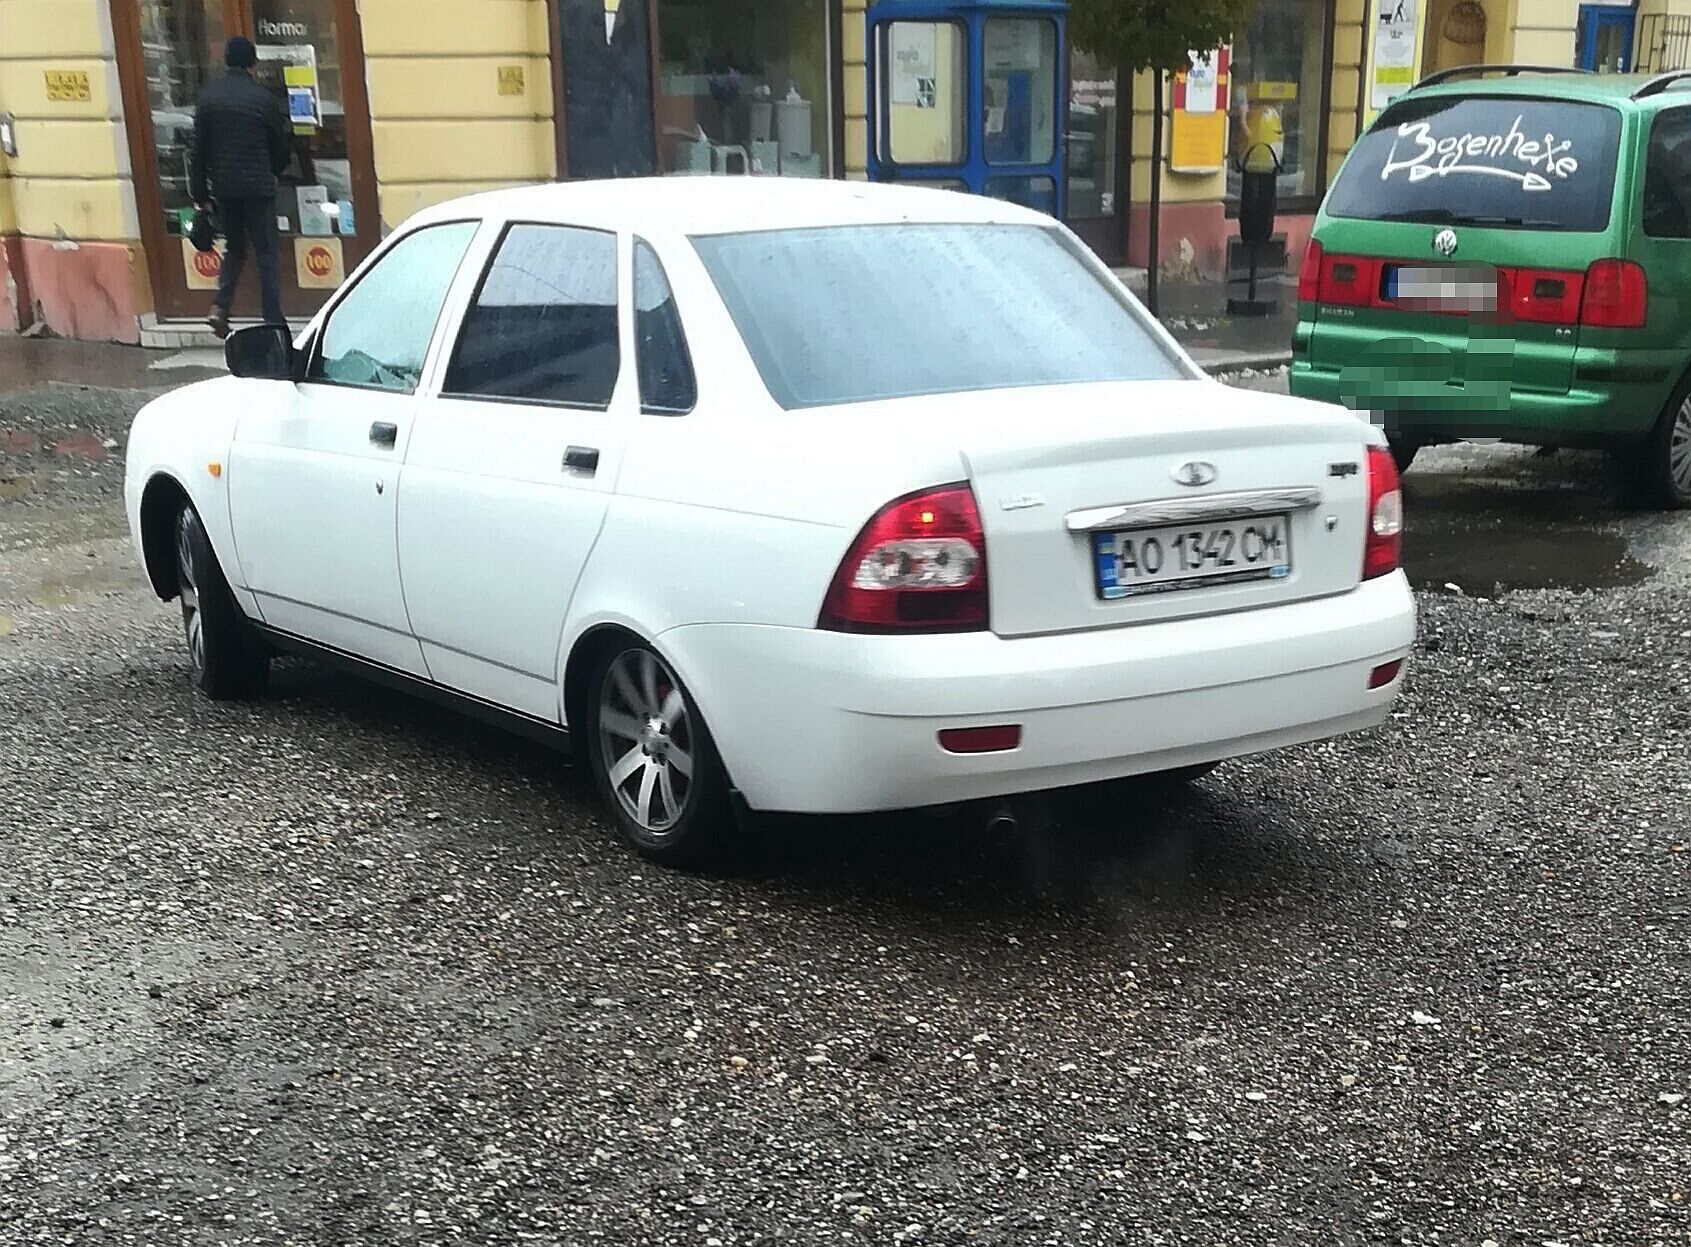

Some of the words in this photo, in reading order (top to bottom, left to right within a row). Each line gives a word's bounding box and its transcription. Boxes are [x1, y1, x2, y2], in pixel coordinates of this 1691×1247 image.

[306, 253, 330, 270] 100
[1118, 537, 1165, 578] AO
[1171, 530, 1236, 572] 1342
